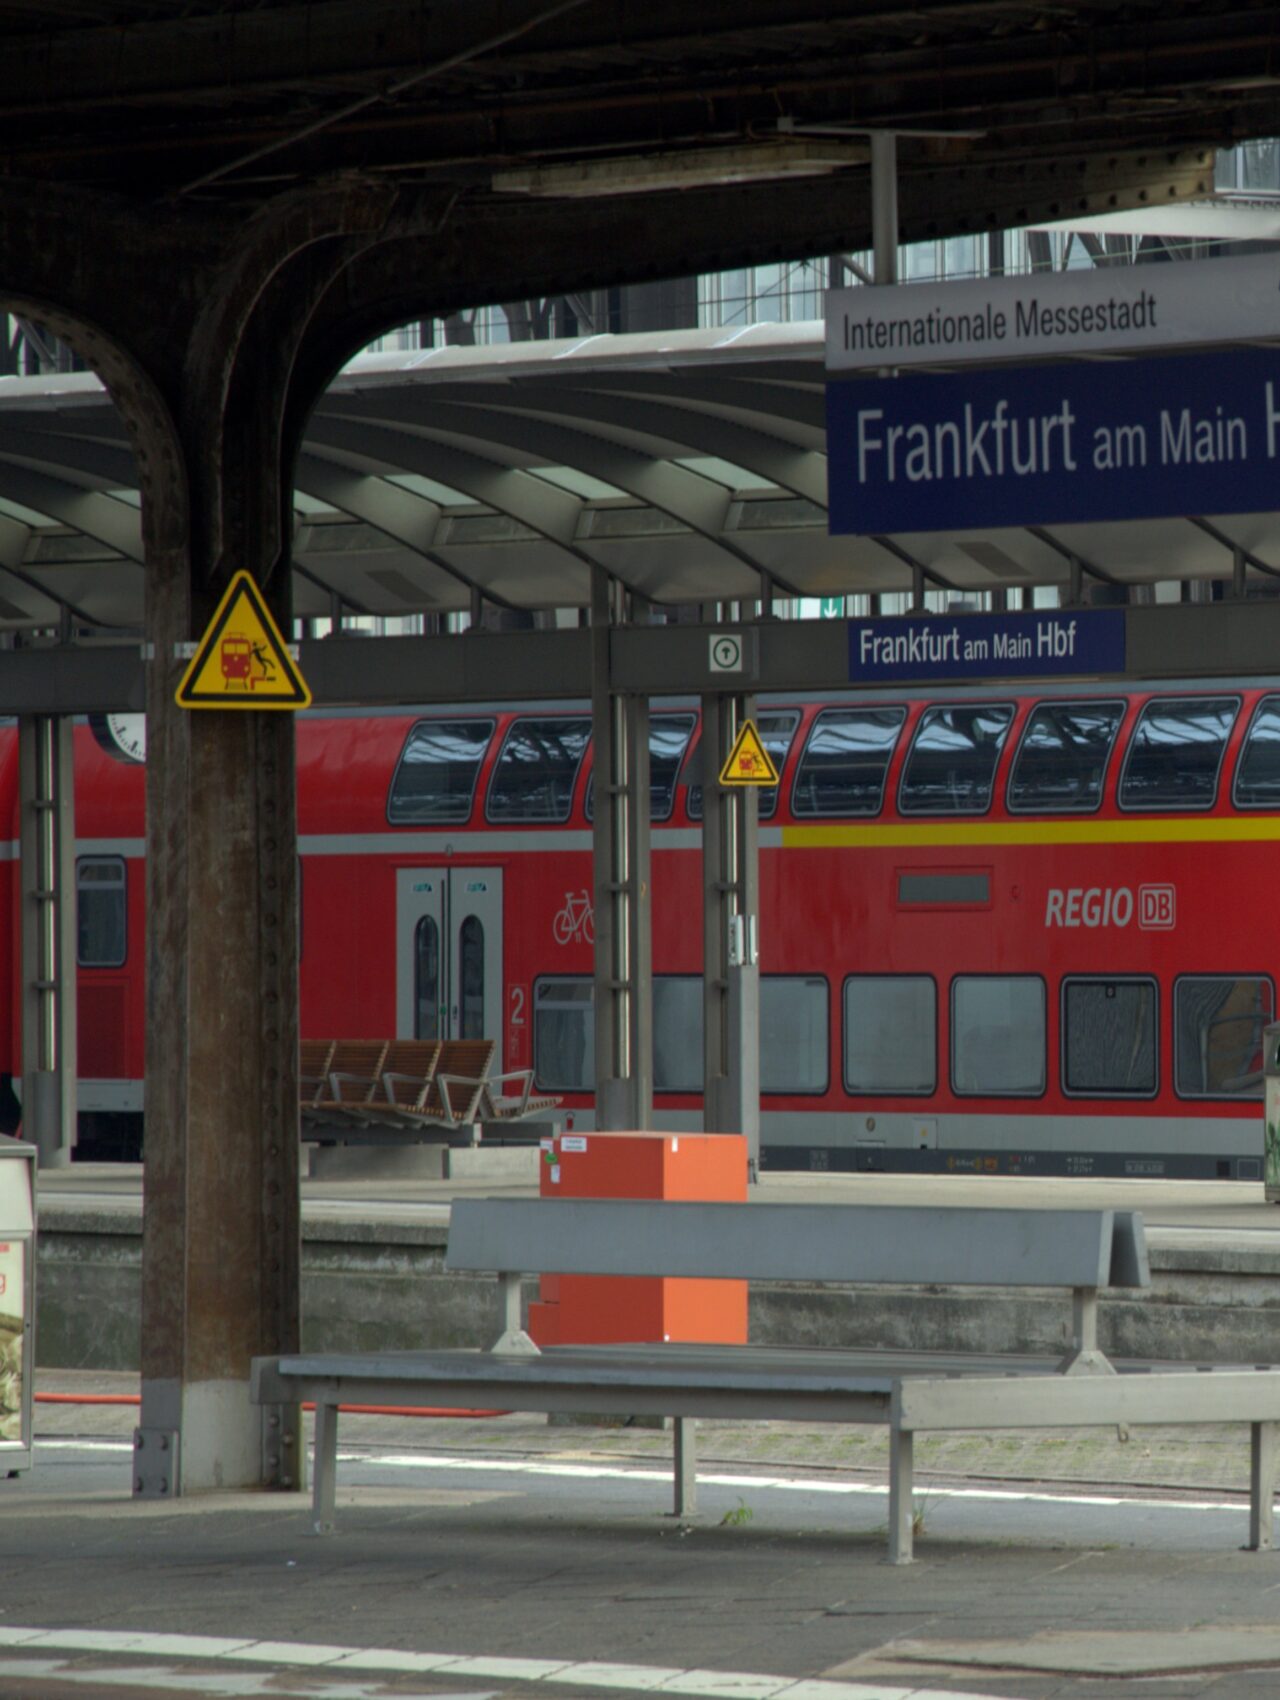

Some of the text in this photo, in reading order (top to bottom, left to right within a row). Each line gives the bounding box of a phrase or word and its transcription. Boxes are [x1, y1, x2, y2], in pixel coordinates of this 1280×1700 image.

[843, 290, 1157, 350] Internationale Messestadt
[857, 399, 1078, 484] Frankfurt
[1093, 422, 1147, 470] am
[1160, 406, 1248, 465] Main
[860, 620, 1077, 664] Frankfurt am Main Hbf
[1045, 887, 1171, 928] REGIO DB
[511, 987, 525, 1025] 2
